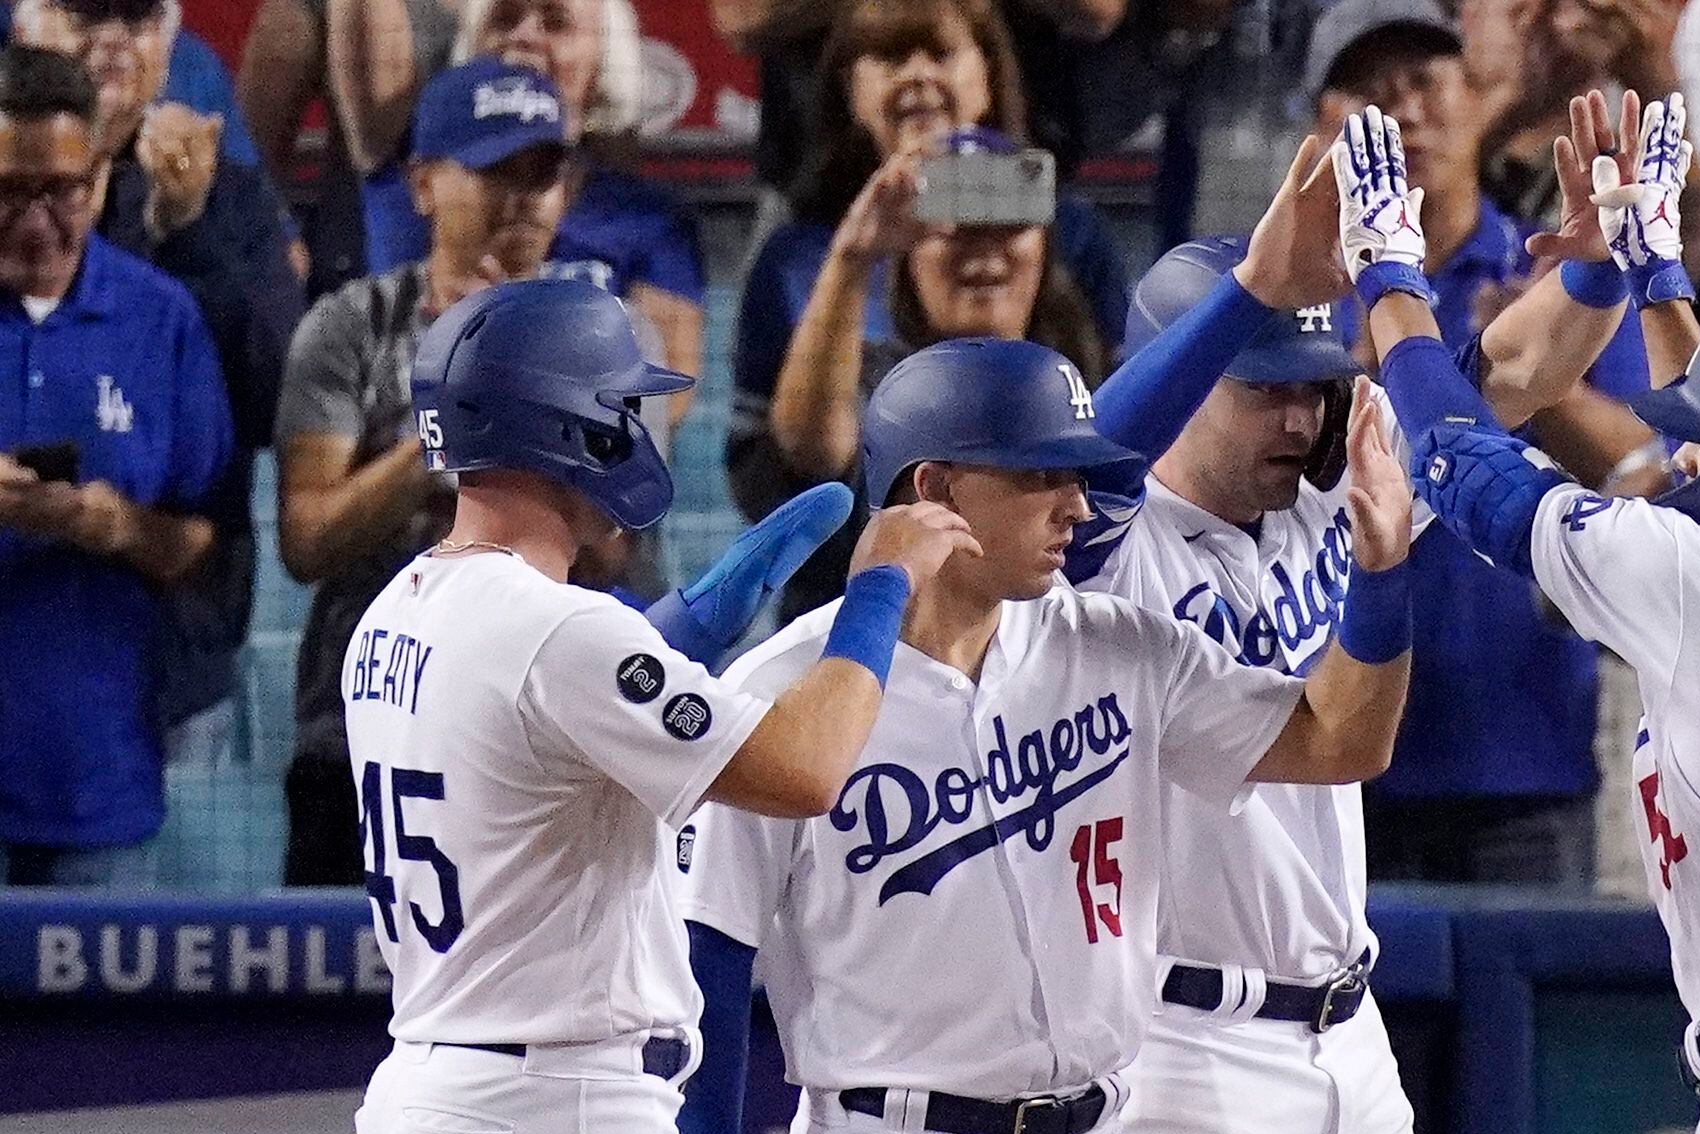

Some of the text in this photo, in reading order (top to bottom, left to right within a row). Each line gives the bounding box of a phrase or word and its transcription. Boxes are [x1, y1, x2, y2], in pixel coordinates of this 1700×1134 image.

[1057, 364, 1095, 419] LA
[418, 408, 445, 450] 45
[352, 629, 433, 715] BEATY
[633, 668, 658, 693] 2
[674, 701, 707, 737] 20
[829, 692, 1133, 875] Dodgers
[359, 760, 465, 954] 45
[1069, 816, 1124, 945] 15
